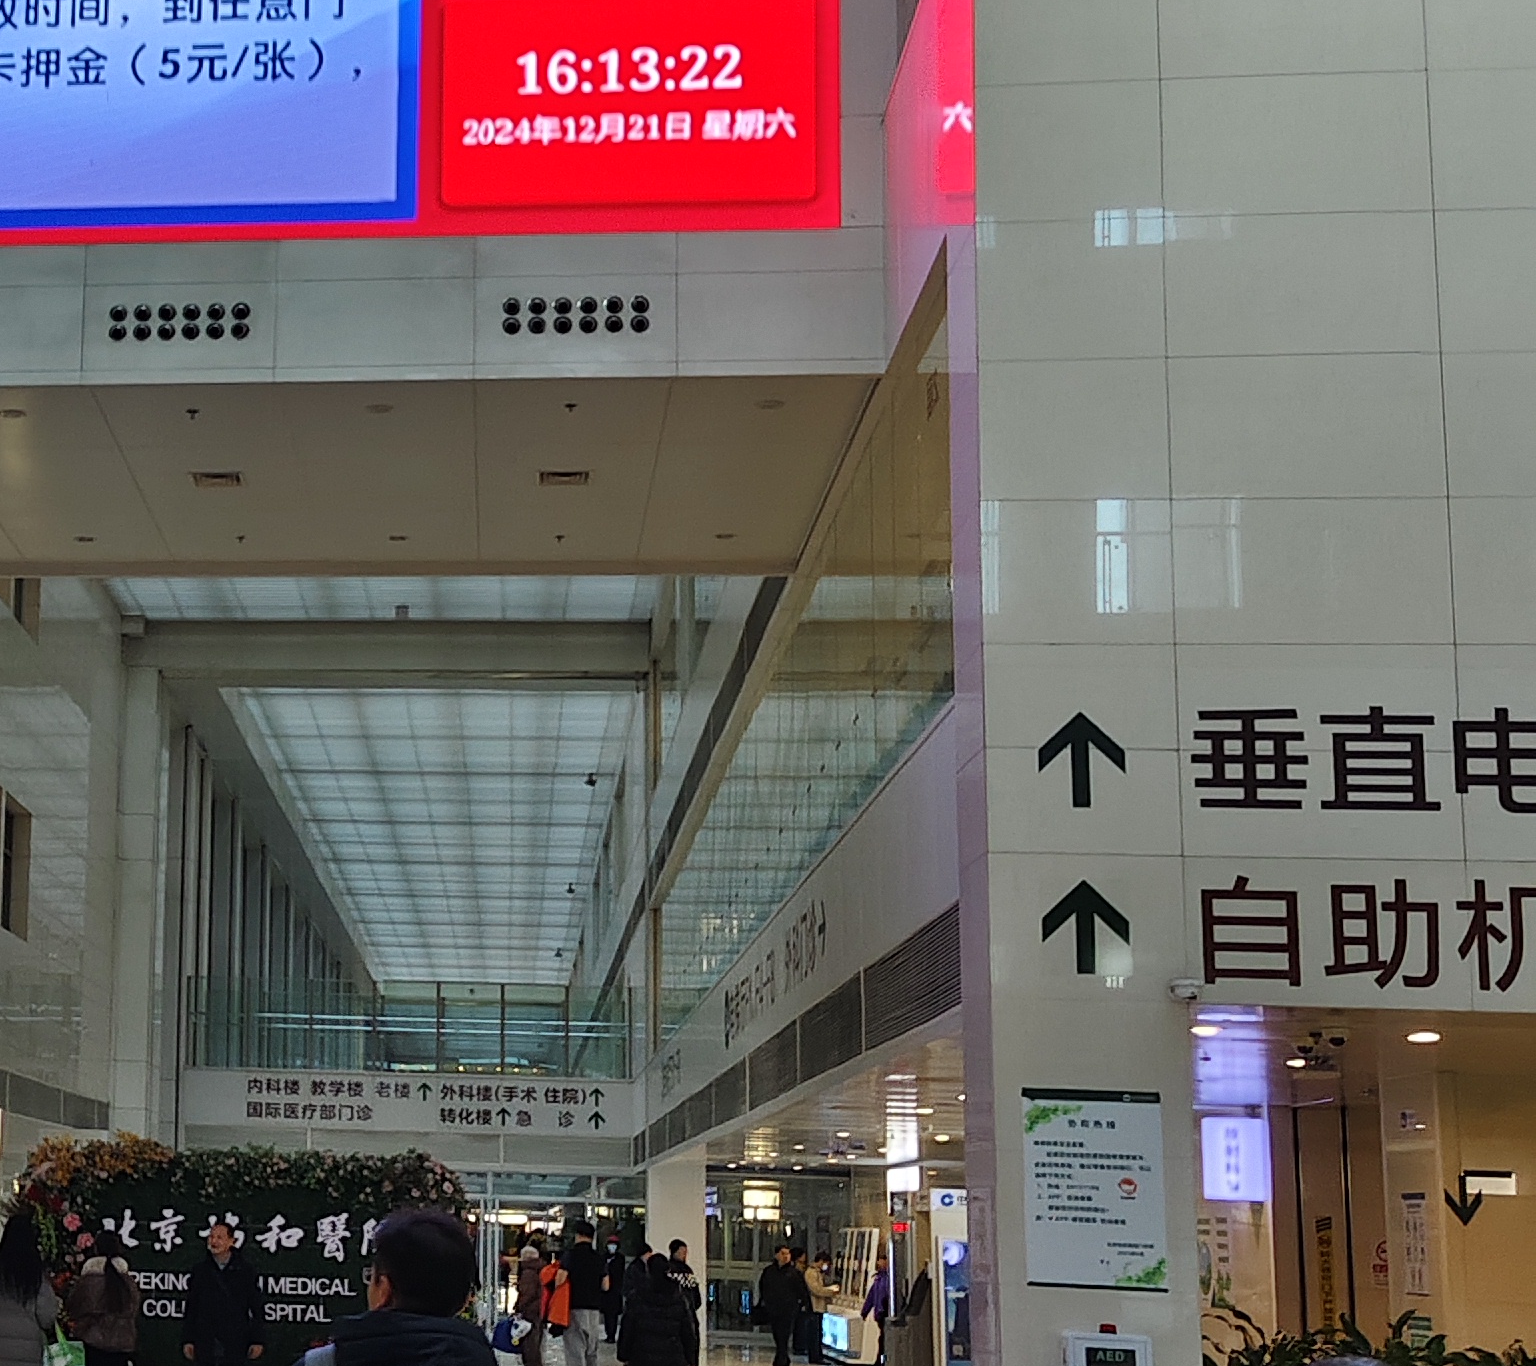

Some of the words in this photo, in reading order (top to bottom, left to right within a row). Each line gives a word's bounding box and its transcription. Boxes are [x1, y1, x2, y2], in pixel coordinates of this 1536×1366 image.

[516, 43, 743, 95] 16:13:22
[463, 111, 693, 147] 2024年12月21日
[701, 106, 797, 142] 星期六
[1189, 705, 1536, 814] 垂直电
[1200, 874, 1536, 993] 自助机
[247, 1077, 300, 1096] 内科楼
[310, 1079, 364, 1098] 教学楼
[374, 1081, 412, 1099] 老楼
[246, 1101, 374, 1121] 国际医疗部门诊
[439, 1107, 493, 1126] 转化楼
[127, 1271, 192, 1291] PEKIN
[267, 1276, 358, 1296] MEDICAL
[142, 1299, 186, 1318] COL
[264, 1303, 333, 1322] SPITAL
[1095, 1350, 1126, 1363] AED
